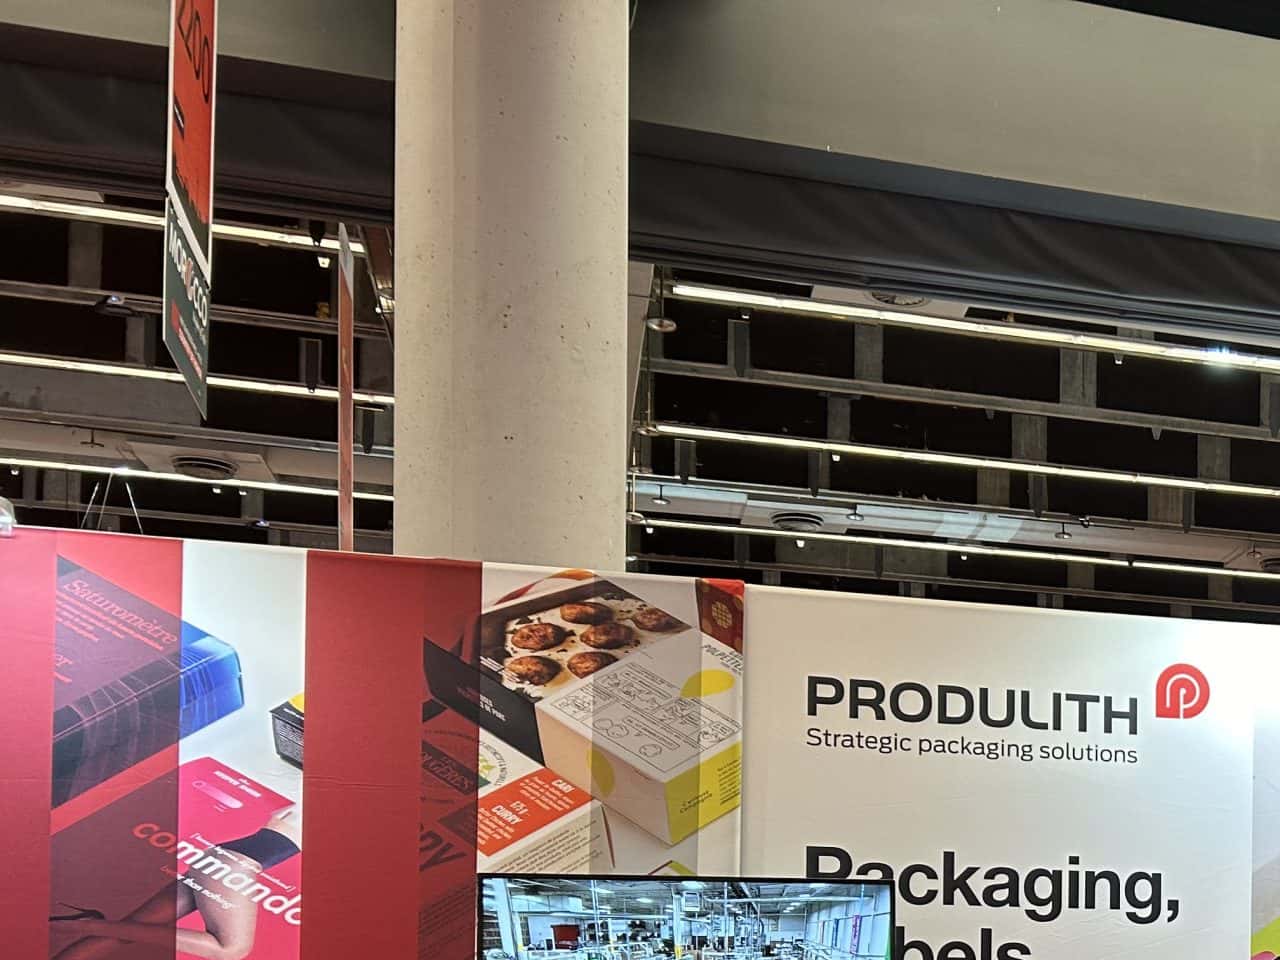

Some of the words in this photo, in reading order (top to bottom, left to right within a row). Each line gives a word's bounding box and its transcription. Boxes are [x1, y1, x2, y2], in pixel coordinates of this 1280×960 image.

[806, 675, 1139, 736] PRODULITH
[806, 727, 912, 752] Strategic
[917, 735, 1034, 763] packaging
[1039, 741, 1139, 765] solutions
[806, 844, 1181, 925] Pckaging,
